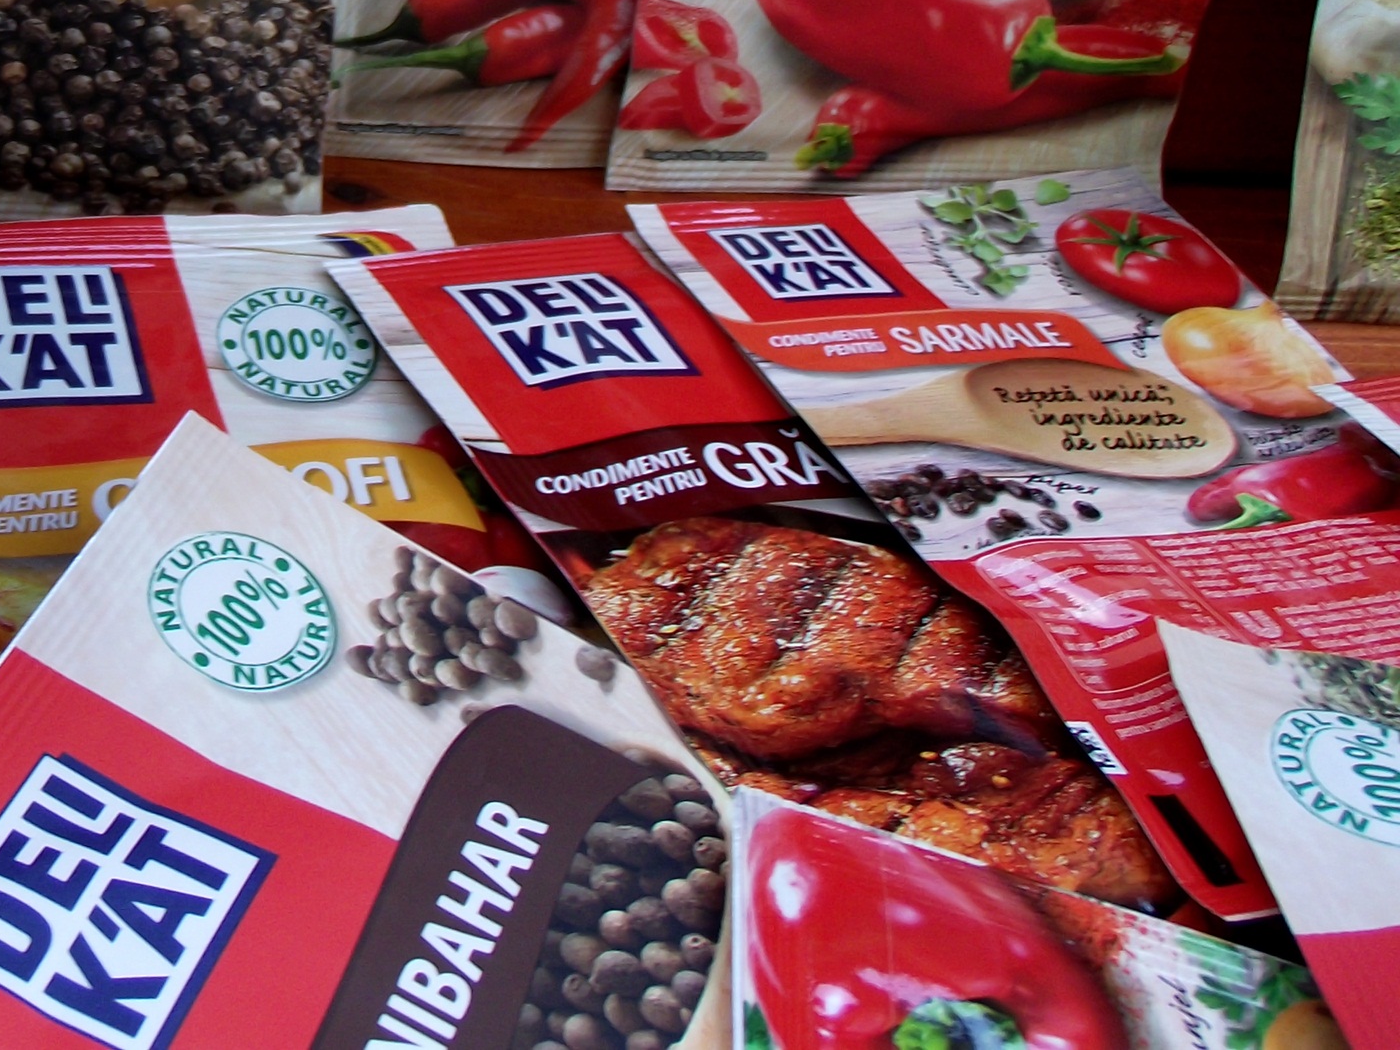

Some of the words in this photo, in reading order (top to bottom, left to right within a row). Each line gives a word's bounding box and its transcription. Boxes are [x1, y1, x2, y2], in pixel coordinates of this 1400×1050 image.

[720, 228, 844, 261] DELI
[227, 289, 362, 334] NATURAL
[460, 275, 631, 327] DELI
[247, 327, 347, 361] 100%
[767, 327, 879, 349] CONDIMENTE
[823, 339, 888, 358] PENTRU
[889, 321, 1072, 355] SARMALE
[237, 358, 372, 397] NATURAL
[1029, 407, 1186, 436] ingrediente
[1061, 432, 1098, 452] de
[1101, 429, 1207, 450] calitate
[535, 445, 697, 495] CONDIMENTE
[613, 467, 708, 506] PENTRU
[1026, 474, 1100, 495] piper
[153, 537, 264, 632] NATURAL
[196, 568, 290, 657] 100%
[233, 575, 330, 686] NATURAL
[1278, 712, 1370, 833] NATURAL
[1334, 734, 1400, 818] 100%
